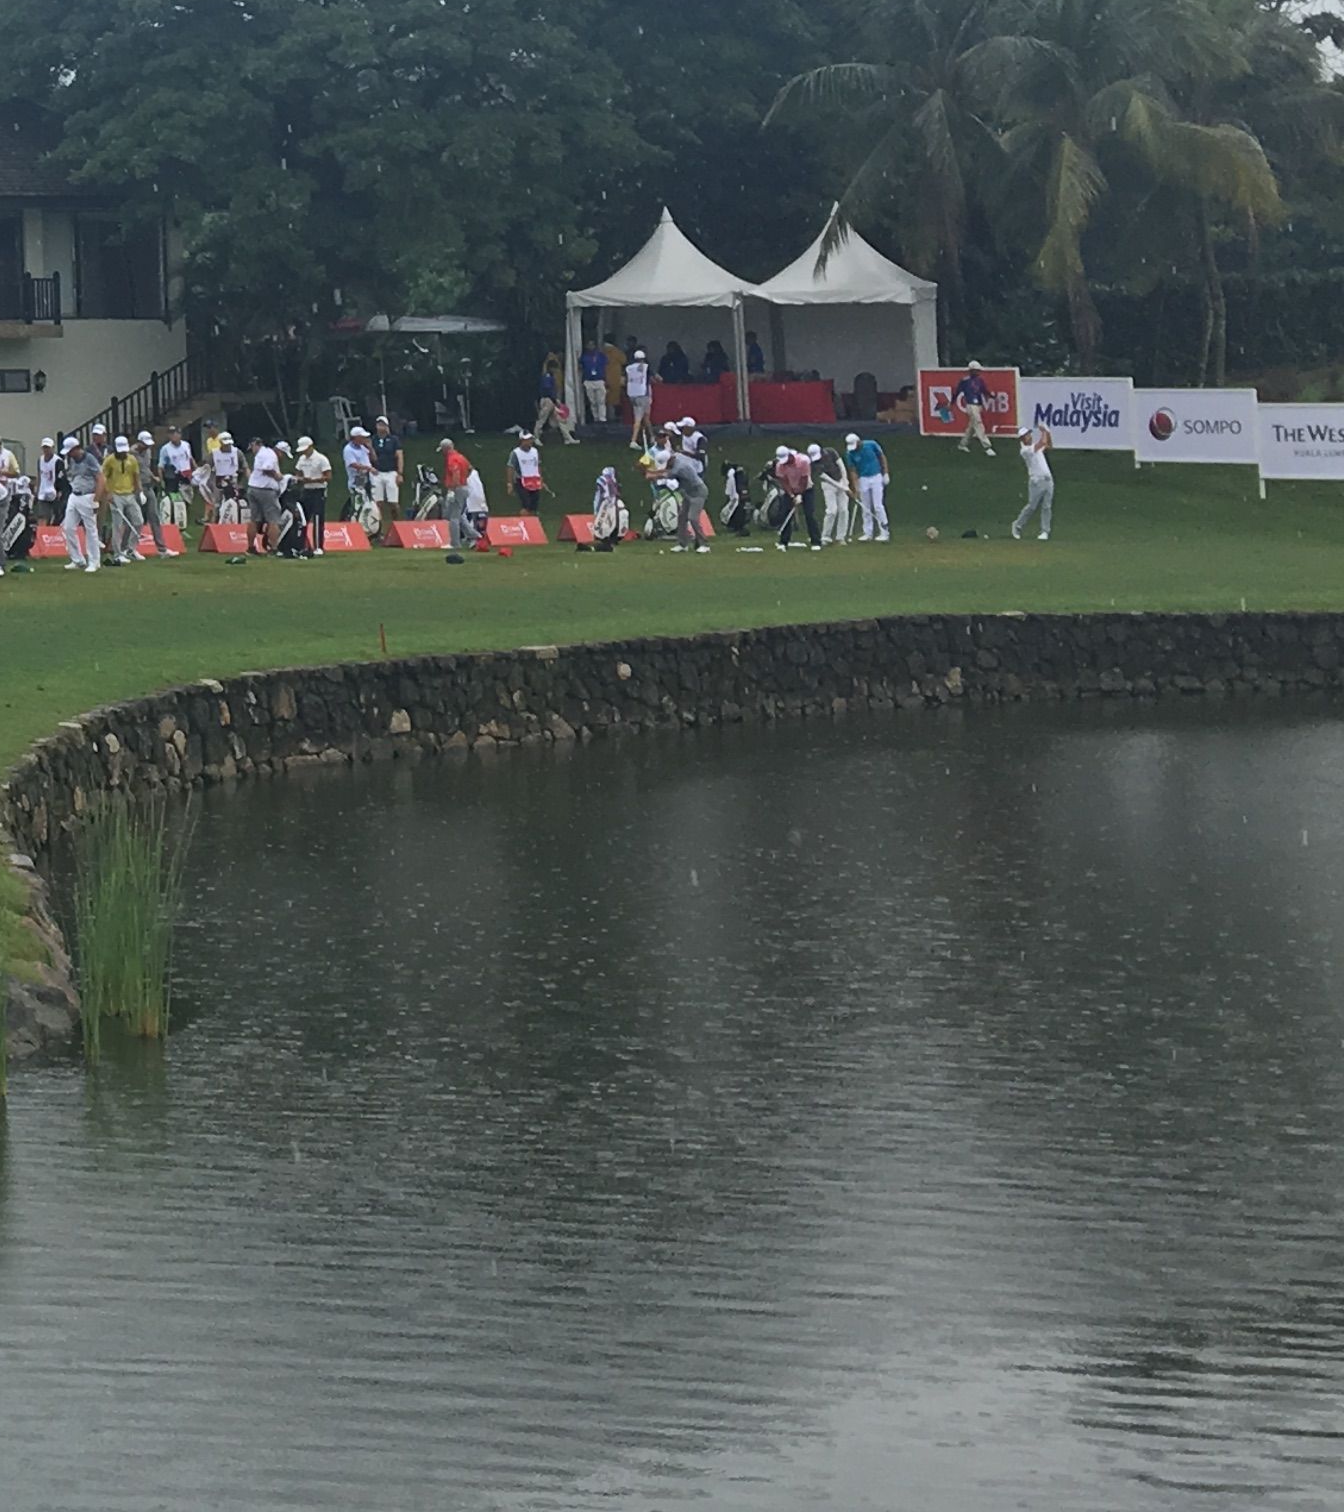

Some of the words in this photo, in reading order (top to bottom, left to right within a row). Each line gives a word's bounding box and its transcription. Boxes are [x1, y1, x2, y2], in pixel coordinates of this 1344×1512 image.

[956, 391, 1010, 413] CMB
[1070, 392, 1103, 410] Visit
[1034, 402, 1120, 433] Malaysia
[1183, 419, 1242, 435] SOMPO
[1272, 424, 1306, 442] THE
